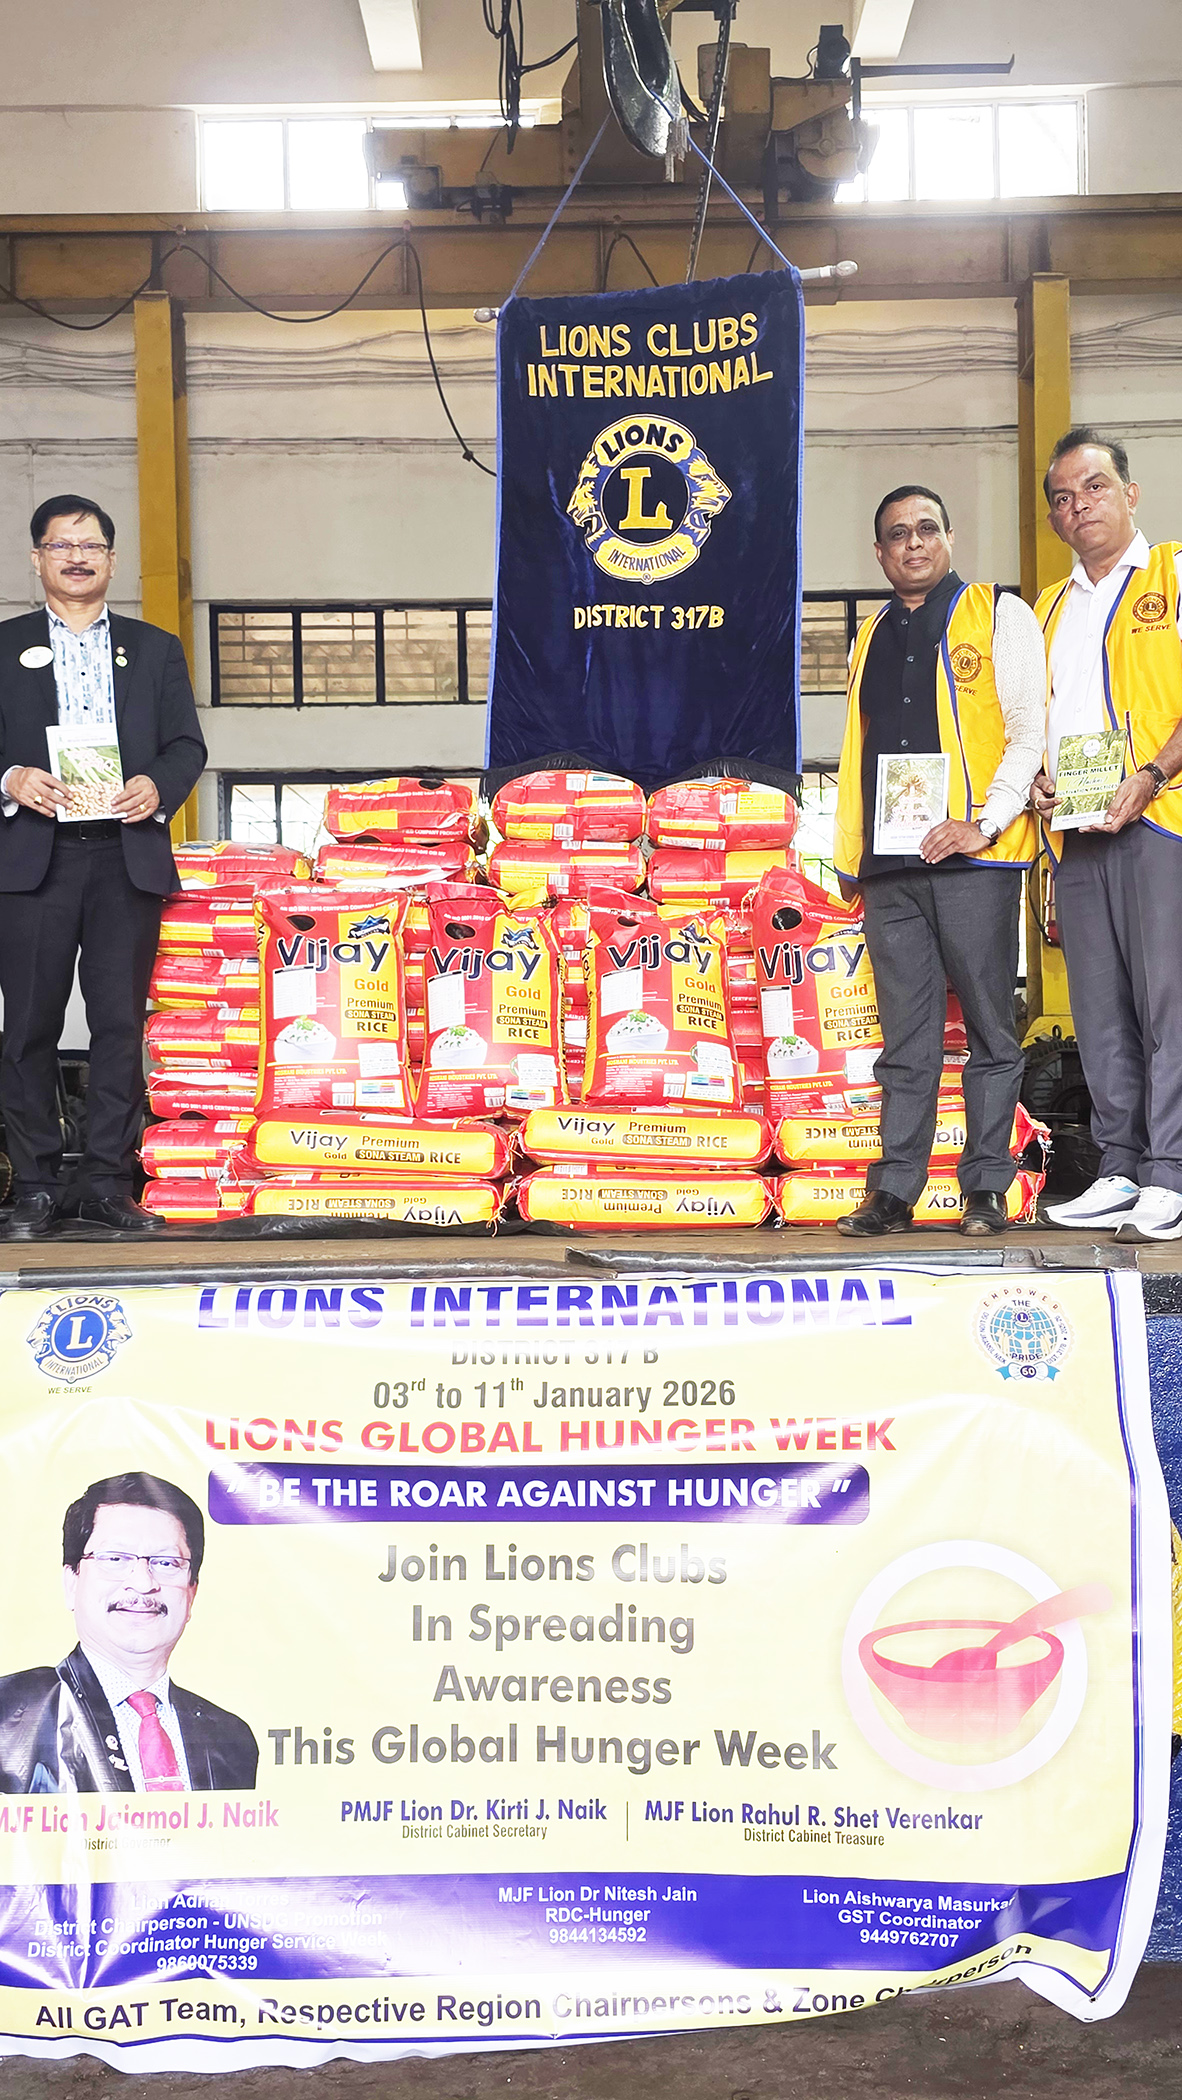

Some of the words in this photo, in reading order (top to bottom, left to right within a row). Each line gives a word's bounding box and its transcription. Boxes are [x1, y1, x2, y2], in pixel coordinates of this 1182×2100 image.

[539, 323, 632, 358] LIONS
[646, 312, 758, 357] CLUBS
[527, 352, 774, 398] INTERNATIONAL
[600, 423, 684, 463] LIONS
[619, 467, 673, 530] L
[607, 548, 687, 572] INTERNATIONAL
[573, 604, 664, 630] DISTRICT
[670, 605, 725, 629] 317B
[1145, 624, 1171, 632] SERVE
[1059, 769, 1088, 777] FINGER
[1090, 765, 1119, 773] MILLET
[277, 934, 391, 973] Vijay
[607, 934, 713, 974] Vijay
[431, 947, 542, 981] Vijay
[759, 942, 866, 984] Vijay
[354, 978, 389, 992] Gold
[506, 985, 541, 1000] Gold
[684, 977, 716, 993] Gold
[830, 983, 869, 999] Gold
[347, 997, 394, 1010] Premium
[678, 993, 722, 1010] Premium
[348, 1010, 370, 1018] SONA
[371, 1011, 395, 1021] STEAM
[499, 1004, 546, 1018] Premium
[679, 1005, 700, 1016] SONA
[701, 1007, 723, 1020] STEAM
[825, 1004, 877, 1018] Premium
[357, 1022, 388, 1033] RICE
[499, 1016, 522, 1025] SONA
[523, 1018, 546, 1028] STEAM
[688, 1016, 717, 1030] RICE
[826, 1020, 850, 1029] SONA
[851, 1016, 878, 1027] STEAM
[508, 1027, 540, 1039] RICE
[837, 1027, 871, 1042] RICE
[558, 1117, 616, 1135] Vijay
[629, 1121, 687, 1134] Premium
[805, 1127, 836, 1139] RICE
[845, 1126, 879, 1136] STEAM
[290, 1130, 348, 1150] Vijay
[362, 1135, 420, 1149] Premium
[591, 1137, 615, 1146] Gold
[626, 1135, 653, 1145] SONA
[655, 1136, 689, 1147] STEAM
[696, 1136, 728, 1148] RICE
[324, 1152, 347, 1160] Gold
[359, 1150, 386, 1160] SONA
[388, 1152, 421, 1162] STEAM
[430, 1152, 461, 1164] RICE
[562, 1188, 593, 1200] RICE
[601, 1189, 634, 1199] STEAM
[636, 1190, 664, 1200] SONA
[813, 1188, 844, 1199] RICE
[927, 1184, 951, 1192] Gold
[288, 1198, 320, 1210] RICE
[328, 1199, 363, 1209] STEAM
[365, 1199, 393, 1209] SONA
[403, 1197, 427, 1205] Gold
[603, 1202, 662, 1214] Premium
[676, 1197, 736, 1216] Vijay
[403, 1206, 462, 1225] Vijay
[56, 1296, 113, 1312] LIONS
[198, 1286, 386, 1329] LIONS
[411, 1279, 912, 1327] INTERNATIONAL
[983, 1288, 1058, 1310] EMPOWER
[66, 1316, 93, 1350] L
[452, 1340, 576, 1365] DISTRICT
[585, 1340, 630, 1365] 317
[643, 1341, 659, 1364] B
[1011, 1352, 1042, 1361] PRIDE
[45, 1357, 104, 1375] INTERNATIONAL
[63, 1386, 93, 1394] SERVE
[373, 1378, 426, 1409] 03rd
[436, 1383, 462, 1409] to
[474, 1378, 524, 1408] 11th
[533, 1381, 652, 1413] January
[663, 1380, 736, 1407] 2026
[206, 1417, 344, 1452] LIONS
[361, 1421, 543, 1453] GLOBAL
[560, 1418, 757, 1452] HUNGER
[770, 1417, 896, 1451] WEEK
[259, 1478, 301, 1507] BE
[312, 1478, 378, 1507] THE
[390, 1479, 487, 1508] ROAR
[496, 1479, 656, 1508] AGAINST
[668, 1477, 821, 1508] HUNGER
[378, 1543, 467, 1582] Join
[485, 1543, 595, 1582] Lions
[612, 1543, 727, 1584] Clubs
[412, 1604, 452, 1641] In
[468, 1603, 694, 1654] Spreading
[433, 1665, 672, 1704] Awareness
[268, 1726, 355, 1765] This
[372, 1723, 517, 1764] Global
[536, 1726, 700, 1775] Hunger
[714, 1729, 838, 1770] Week
[197, 1803, 213, 1829] J.
[223, 1800, 279, 1828] Naik
[341, 1800, 393, 1822] PMJF
[401, 1799, 442, 1821] Lion
[451, 1799, 478, 1821] Dr.
[487, 1799, 528, 1820] Kirti
[536, 1799, 550, 1821] J.
[558, 1799, 607, 1820] Naik
[645, 1800, 684, 1821] MJF
[692, 1801, 734, 1823] Lion
[741, 1803, 800, 1826] Rahul
[808, 1806, 826, 1827] R.
[834, 1806, 879, 1829] Shet
[886, 1807, 983, 1830] Verenkar
[402, 1824, 442, 1839] District
[447, 1824, 489, 1838] Cabinet
[493, 1824, 547, 1840] Secretary
[744, 1828, 784, 1843] District
[788, 1829, 831, 1844] Cabinet
[835, 1831, 885, 1846] Treasure
[499, 1887, 533, 1902] MJF
[538, 1886, 574, 1901] Lion
[580, 1886, 600, 1901] Dr
[604, 1886, 657, 1901] Nitesh
[661, 1886, 697, 1901] Jain
[803, 1889, 840, 1904] Lion
[844, 1891, 932, 1912] Aishwarya
[938, 1895, 1016, 1912] Masurkar
[35, 1919, 97, 1936] District
[101, 1917, 207, 1936] Chairperson
[297, 1912, 383, 1927] Promotion
[545, 1907, 651, 1925] RDC-Hunger
[838, 1910, 874, 1923] GST
[879, 1911, 981, 1930] Coordinator
[549, 1927, 647, 1943] 9844134592
[860, 1929, 959, 1947] 9449762707
[27, 1941, 91, 1959] District
[95, 1935, 200, 1956] Coordinator
[204, 1934, 267, 1952] Hunger
[272, 1933, 335, 1949] Service
[341, 1931, 387, 1948] Week
[35, 2006, 73, 2029] All
[83, 2003, 149, 2030] GAT
[159, 1998, 247, 2029] Team,
[258, 1995, 426, 2031] Respective
[437, 1994, 541, 2026] Region
[551, 1991, 751, 2020] Chairpersons
[763, 1987, 783, 2014] &
[793, 1987, 865, 2013] Zone
